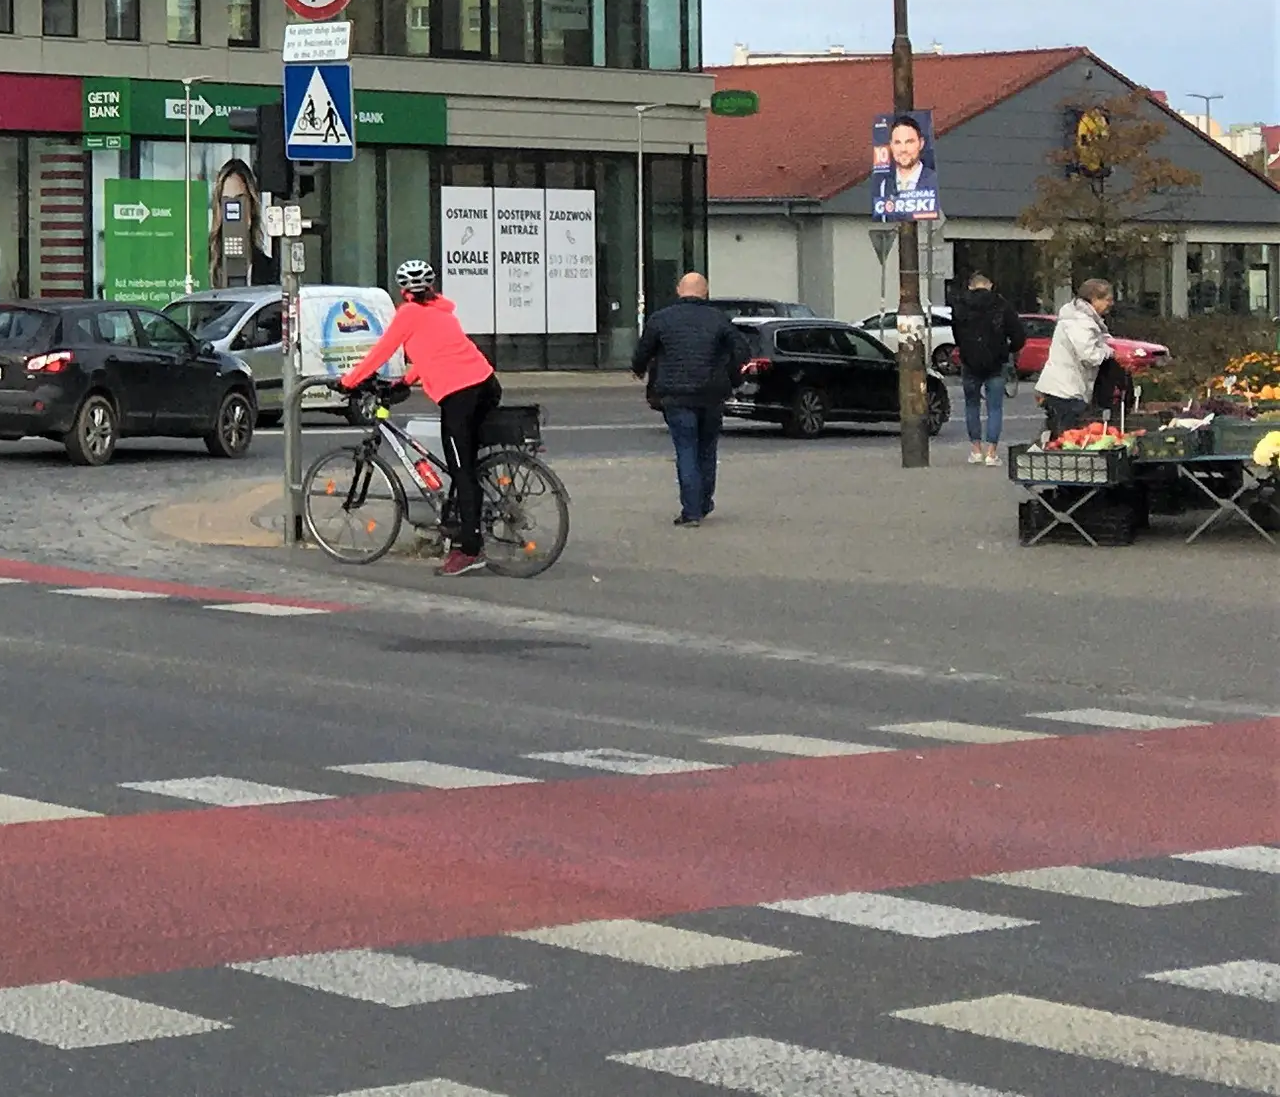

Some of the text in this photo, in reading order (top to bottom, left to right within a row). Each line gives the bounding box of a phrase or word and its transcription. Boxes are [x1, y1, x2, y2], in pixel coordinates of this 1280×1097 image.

[87, 92, 120, 104] GETIN
[89, 106, 120, 118] BANK
[195, 104, 205, 115] IN
[358, 111, 385, 124] BANK
[446, 208, 488, 220] OSTATNIE
[497, 209, 542, 222] DOSTĘPNE
[549, 209, 592, 221] ZADZWOŃ
[501, 222, 539, 235] METRAŻE
[446, 251, 489, 264] LOKALE
[501, 251, 540, 265] PARTER
[447, 268, 457, 276] NA
